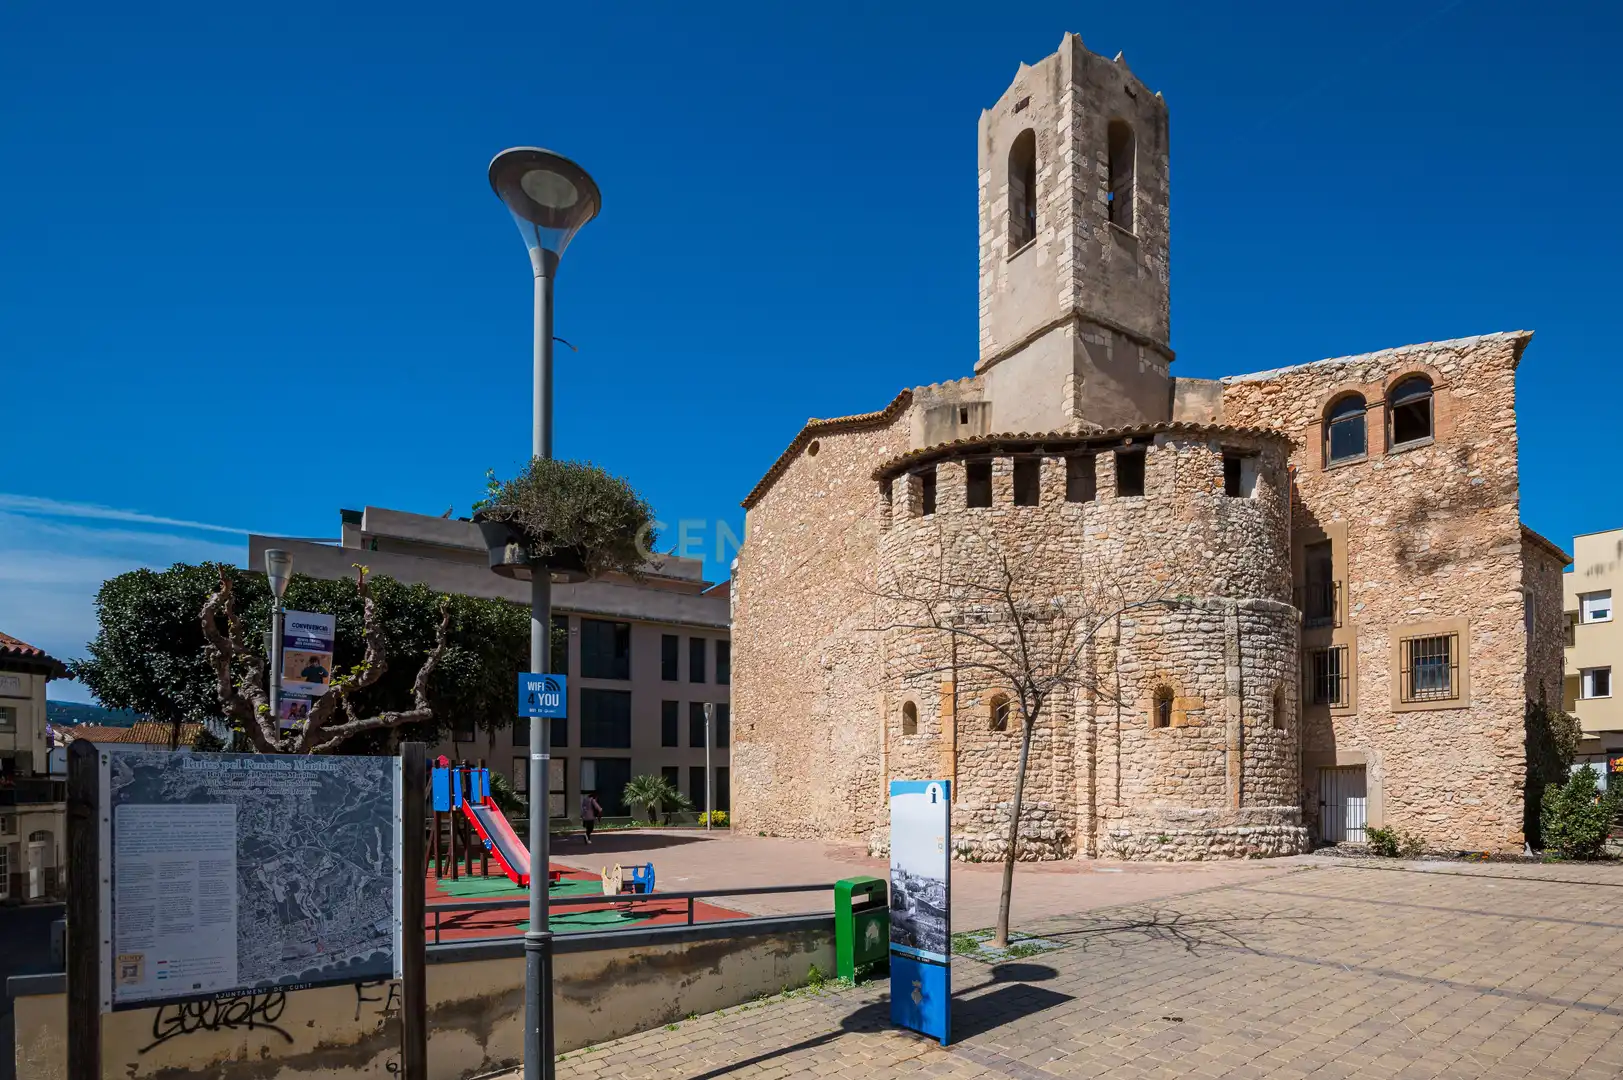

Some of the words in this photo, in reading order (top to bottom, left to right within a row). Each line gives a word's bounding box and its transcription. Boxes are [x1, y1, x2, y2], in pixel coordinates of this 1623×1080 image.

[527, 681, 545, 691] WIFI
[527, 692, 535, 706] 4
[538, 692, 559, 707] YOU
[215, 987, 268, 999] AJUNTAMENT
[273, 984, 284, 993] DE
[289, 982, 312, 991] CUNIT
